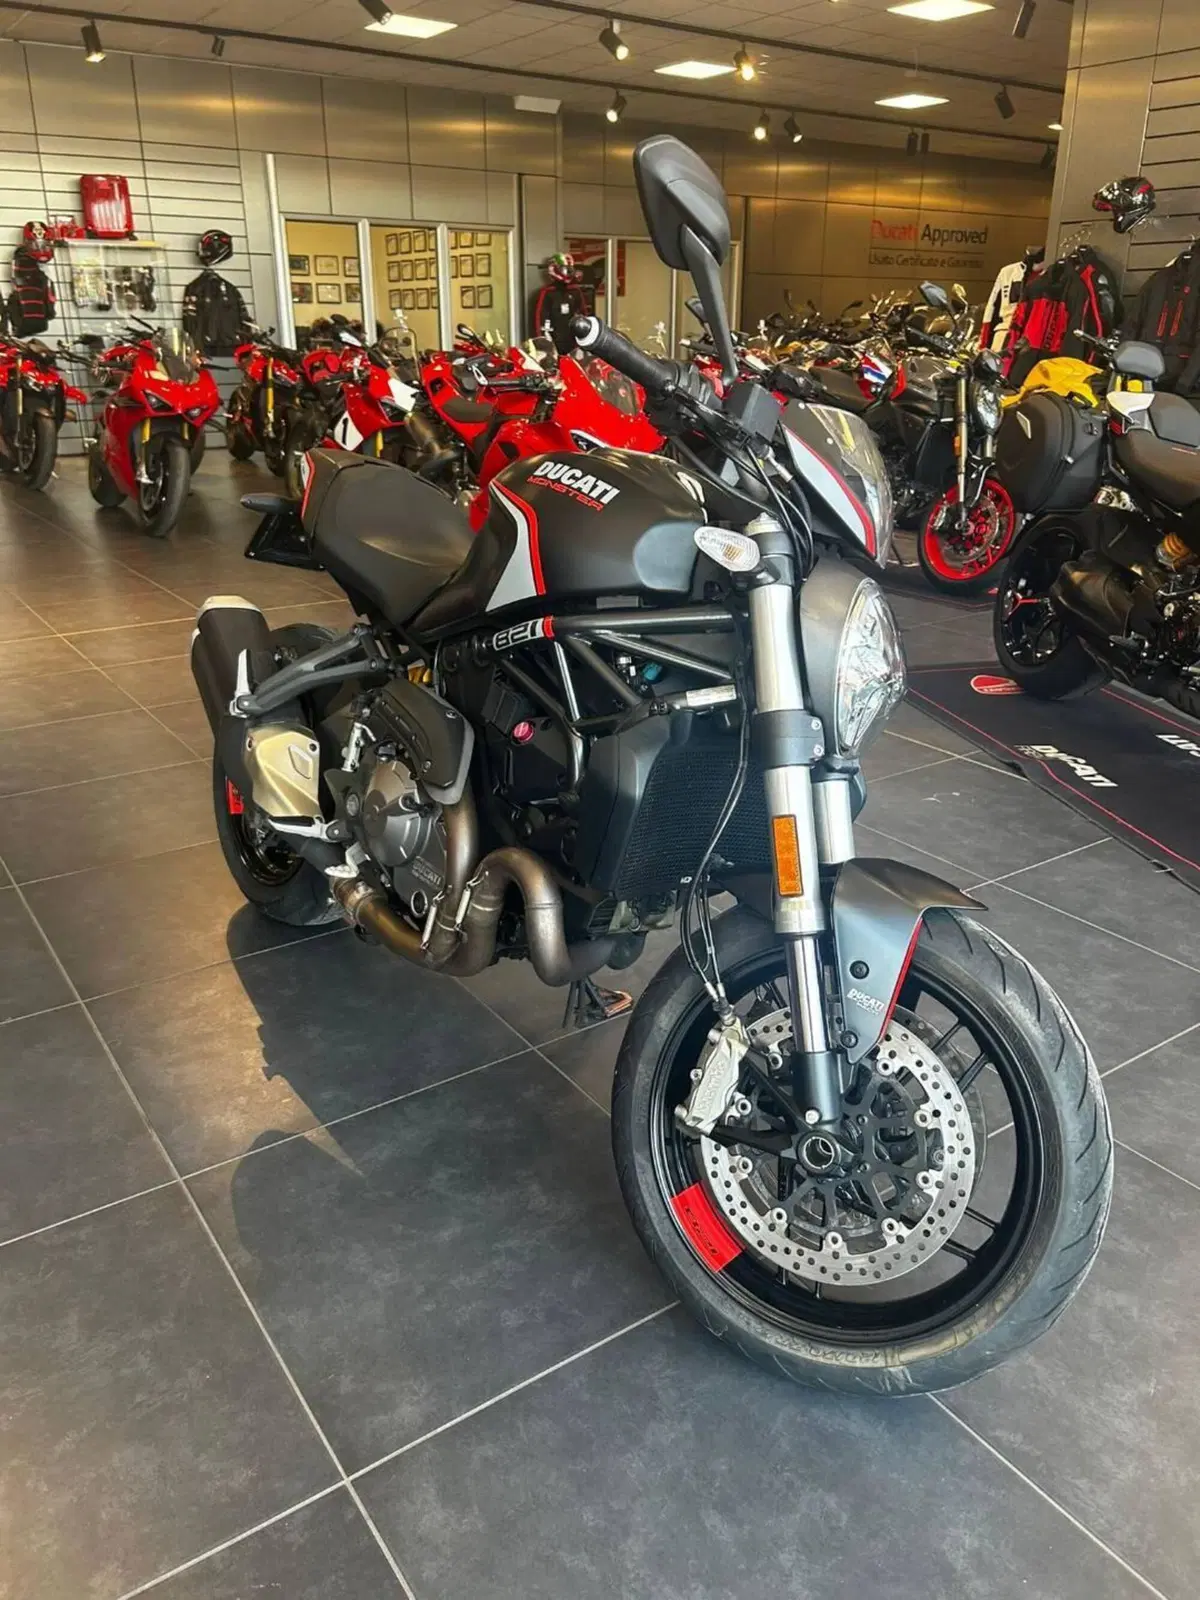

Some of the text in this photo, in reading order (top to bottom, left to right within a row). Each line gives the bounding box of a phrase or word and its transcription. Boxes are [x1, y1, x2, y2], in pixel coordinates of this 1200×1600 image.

[871, 219, 988, 247] Ducati Approved
[341, 416, 349, 446] 1
[526, 475, 605, 513] MONSTER
[533, 460, 621, 505] DUCATI
[492, 617, 543, 651] 821
[1029, 744, 1119, 787] DUCATI
[846, 987, 885, 1011] DUCATI
